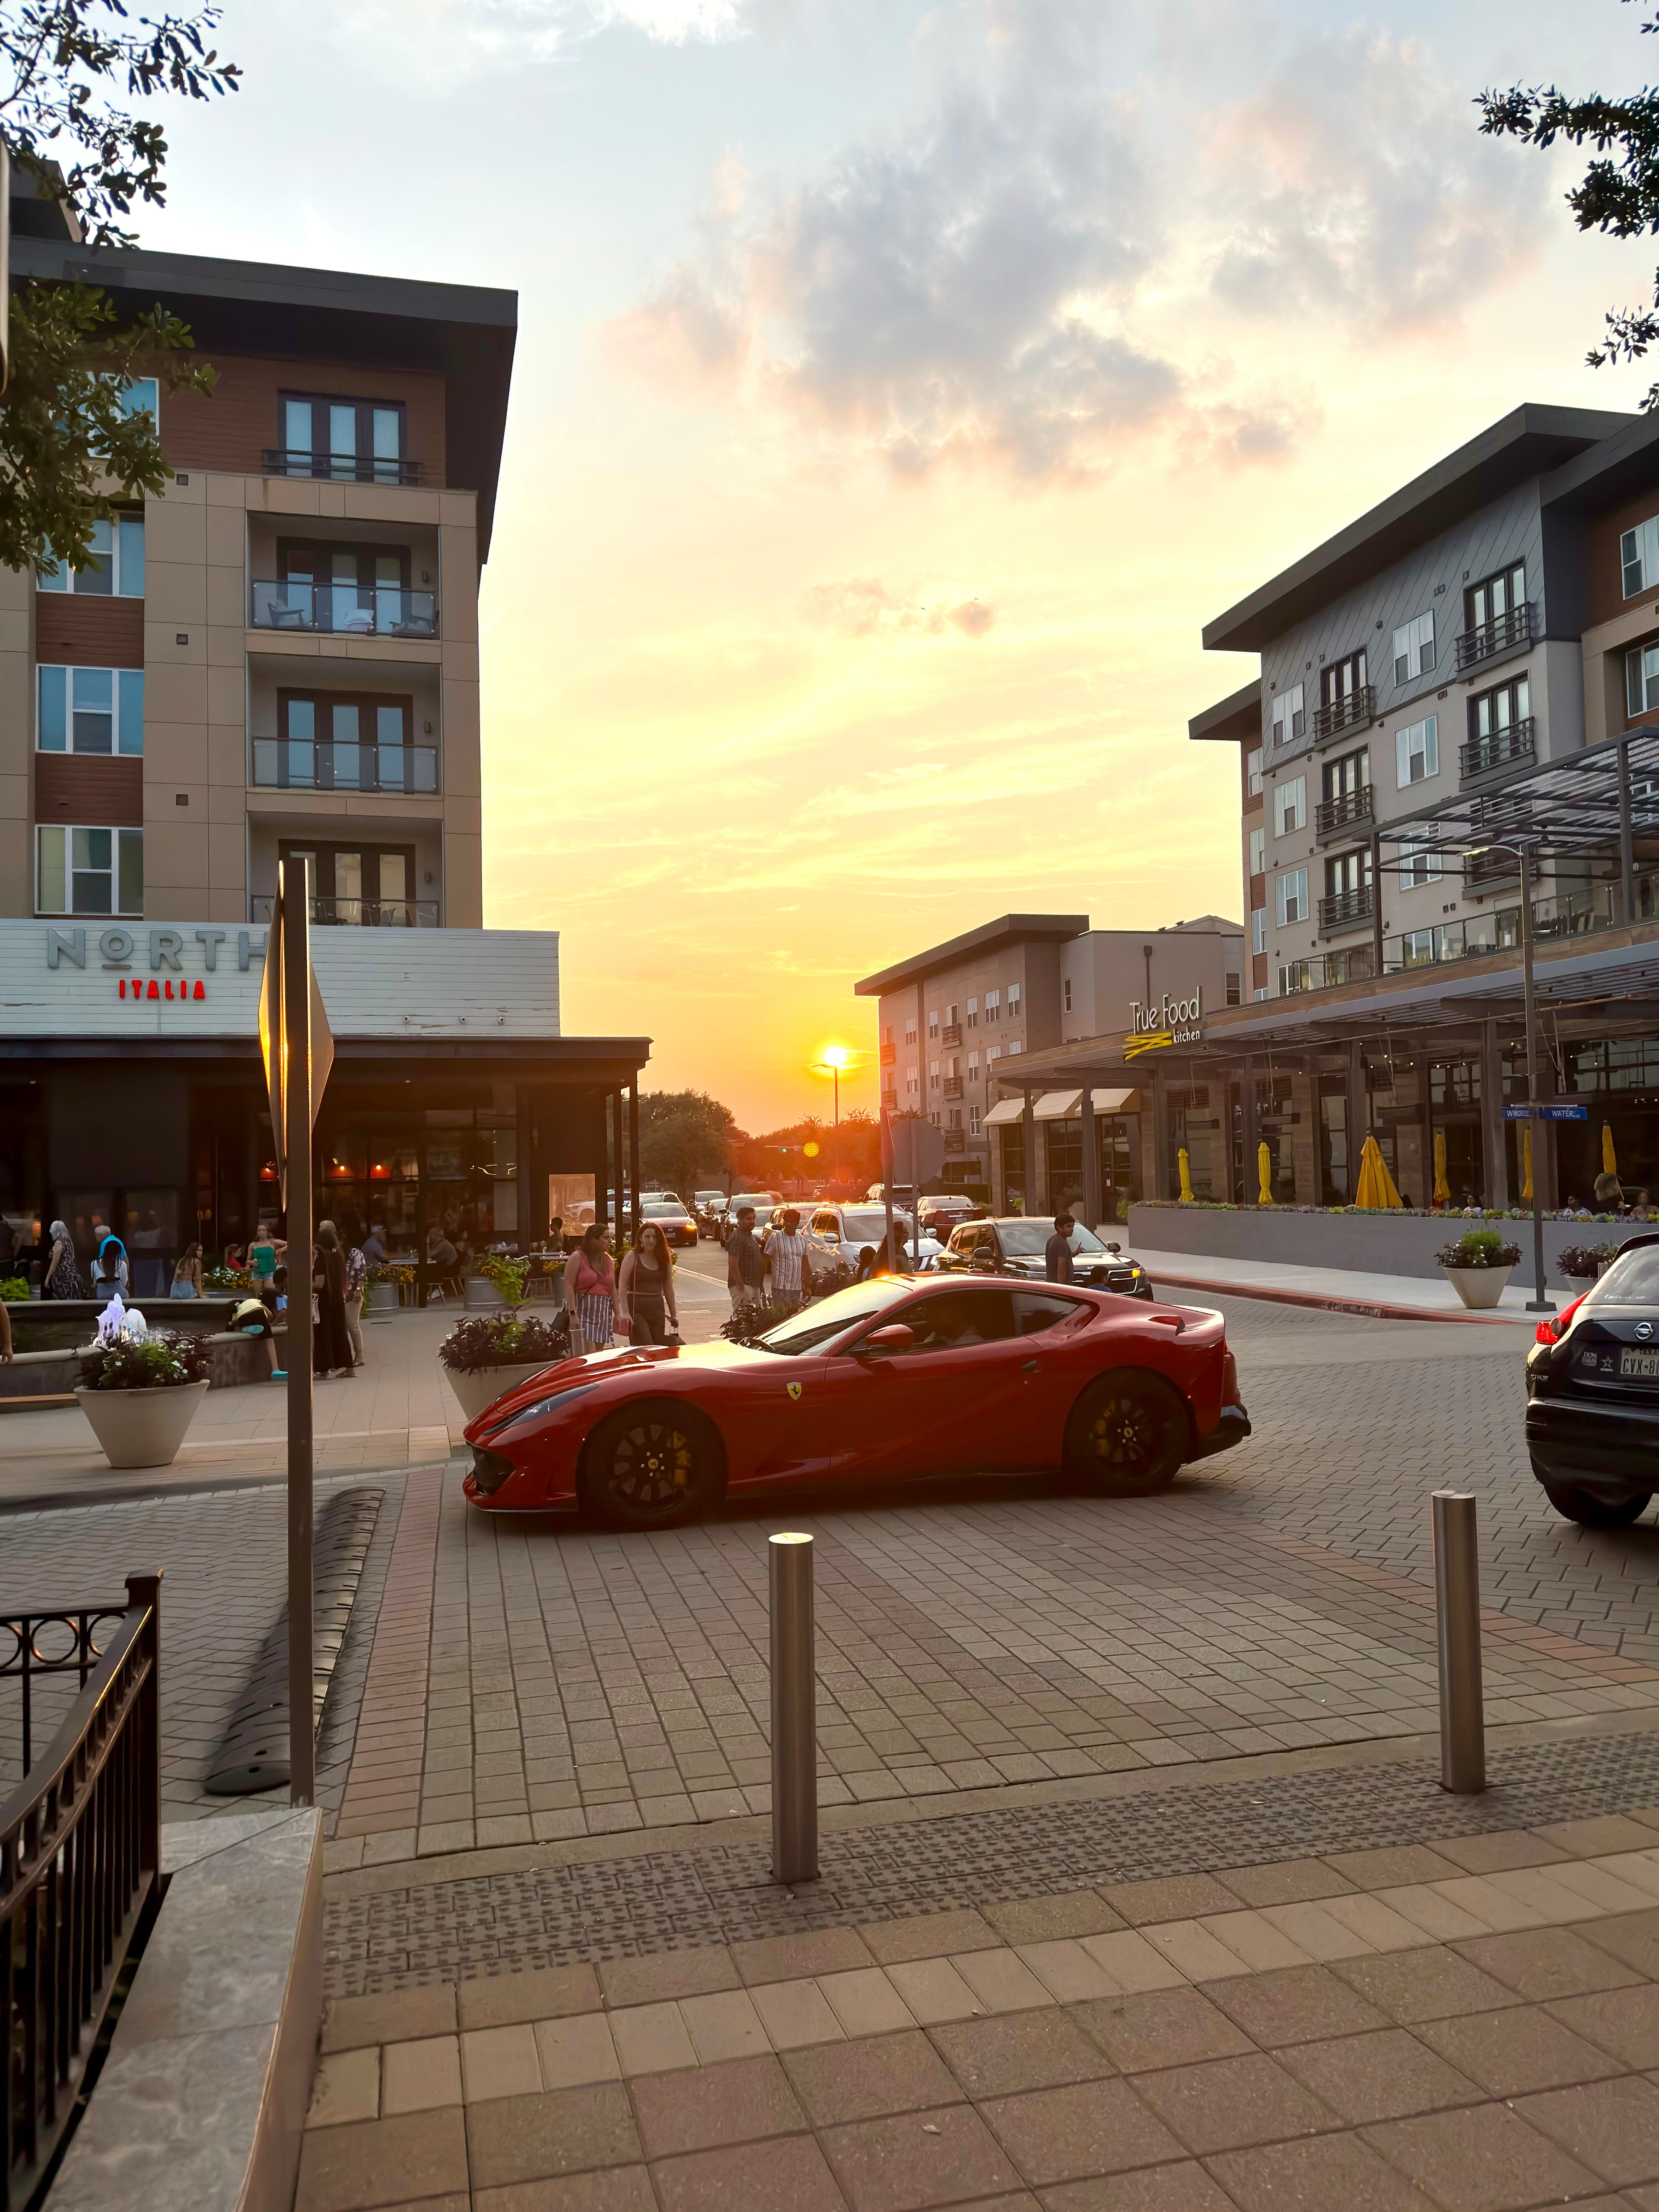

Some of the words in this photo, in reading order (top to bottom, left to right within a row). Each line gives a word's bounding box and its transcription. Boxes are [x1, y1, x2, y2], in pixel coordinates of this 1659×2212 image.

[48, 928, 269, 971] NORTH
[119, 979, 206, 999] ITALIA
[1129, 1002, 1158, 1035] True
[1163, 985, 1201, 1029] Food
[1173, 1026, 1200, 1044] kitchen
